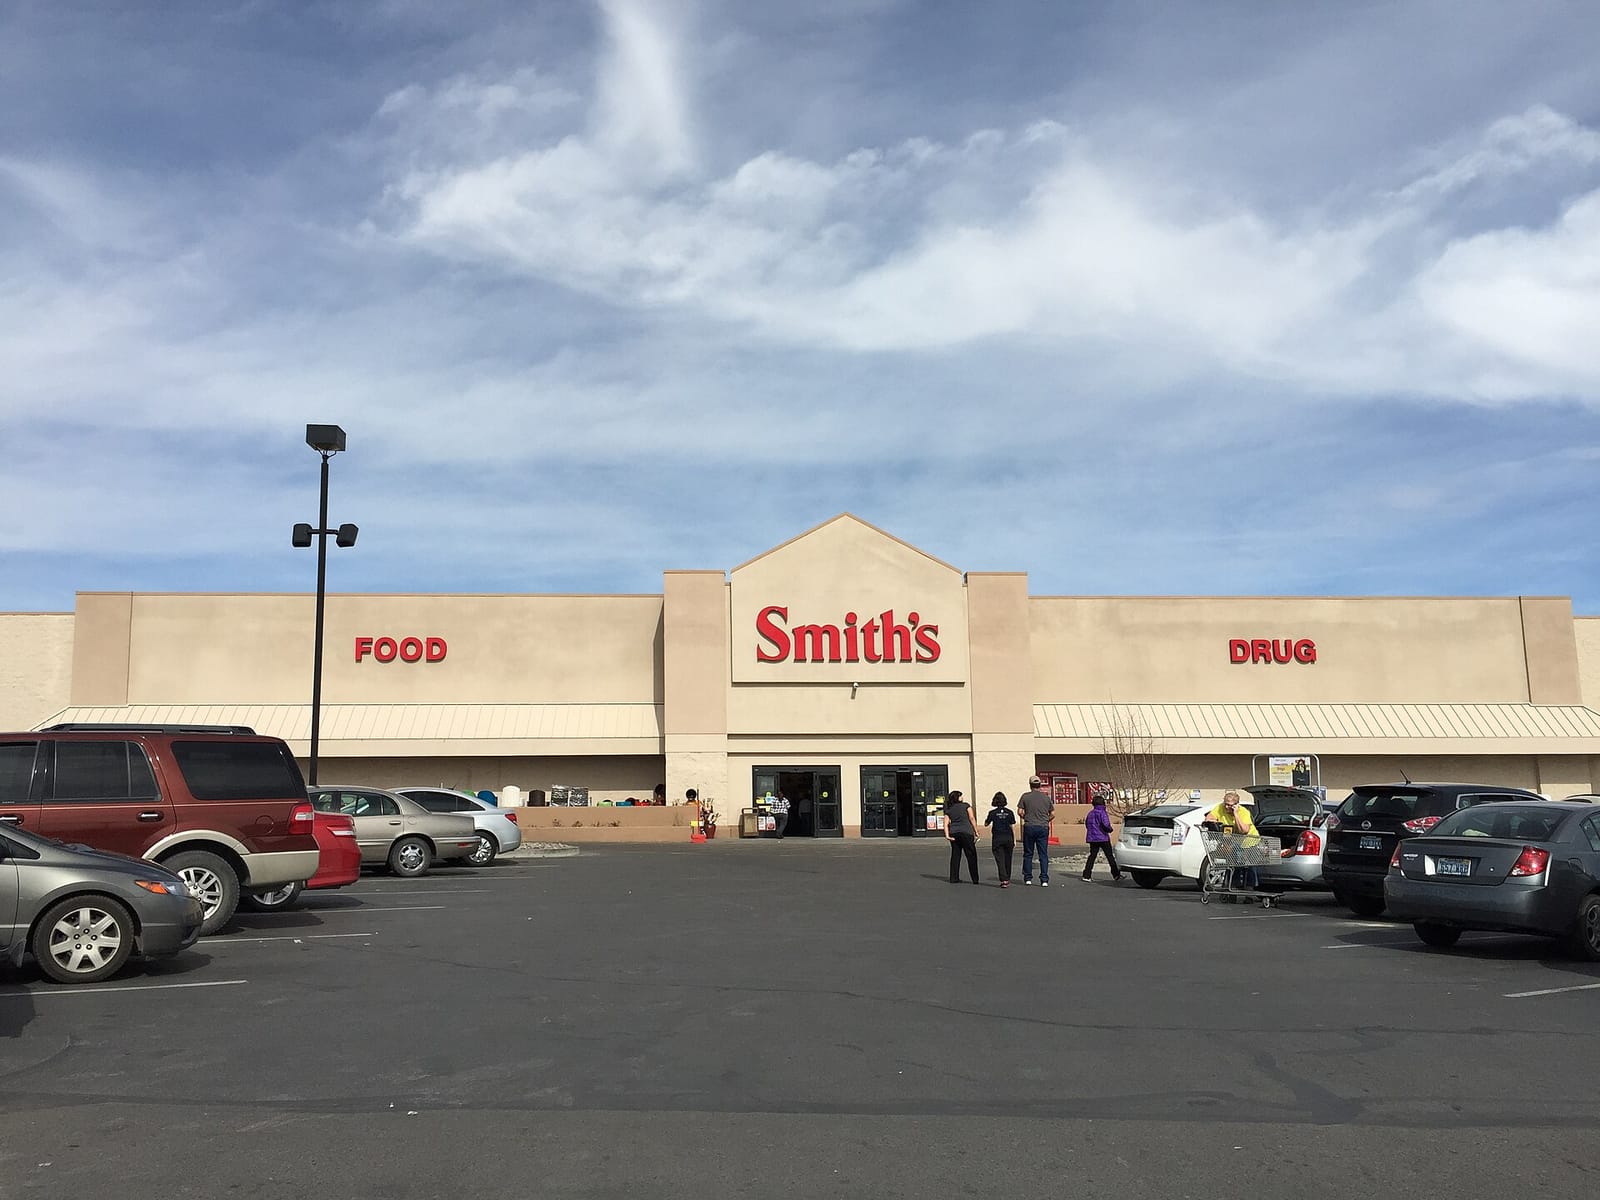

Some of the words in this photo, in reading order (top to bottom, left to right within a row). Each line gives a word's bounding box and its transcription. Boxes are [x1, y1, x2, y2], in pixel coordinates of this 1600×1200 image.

[756, 606, 941, 663] Smith's
[355, 637, 447, 663] FOOD
[1229, 639, 1317, 664] DRUG
